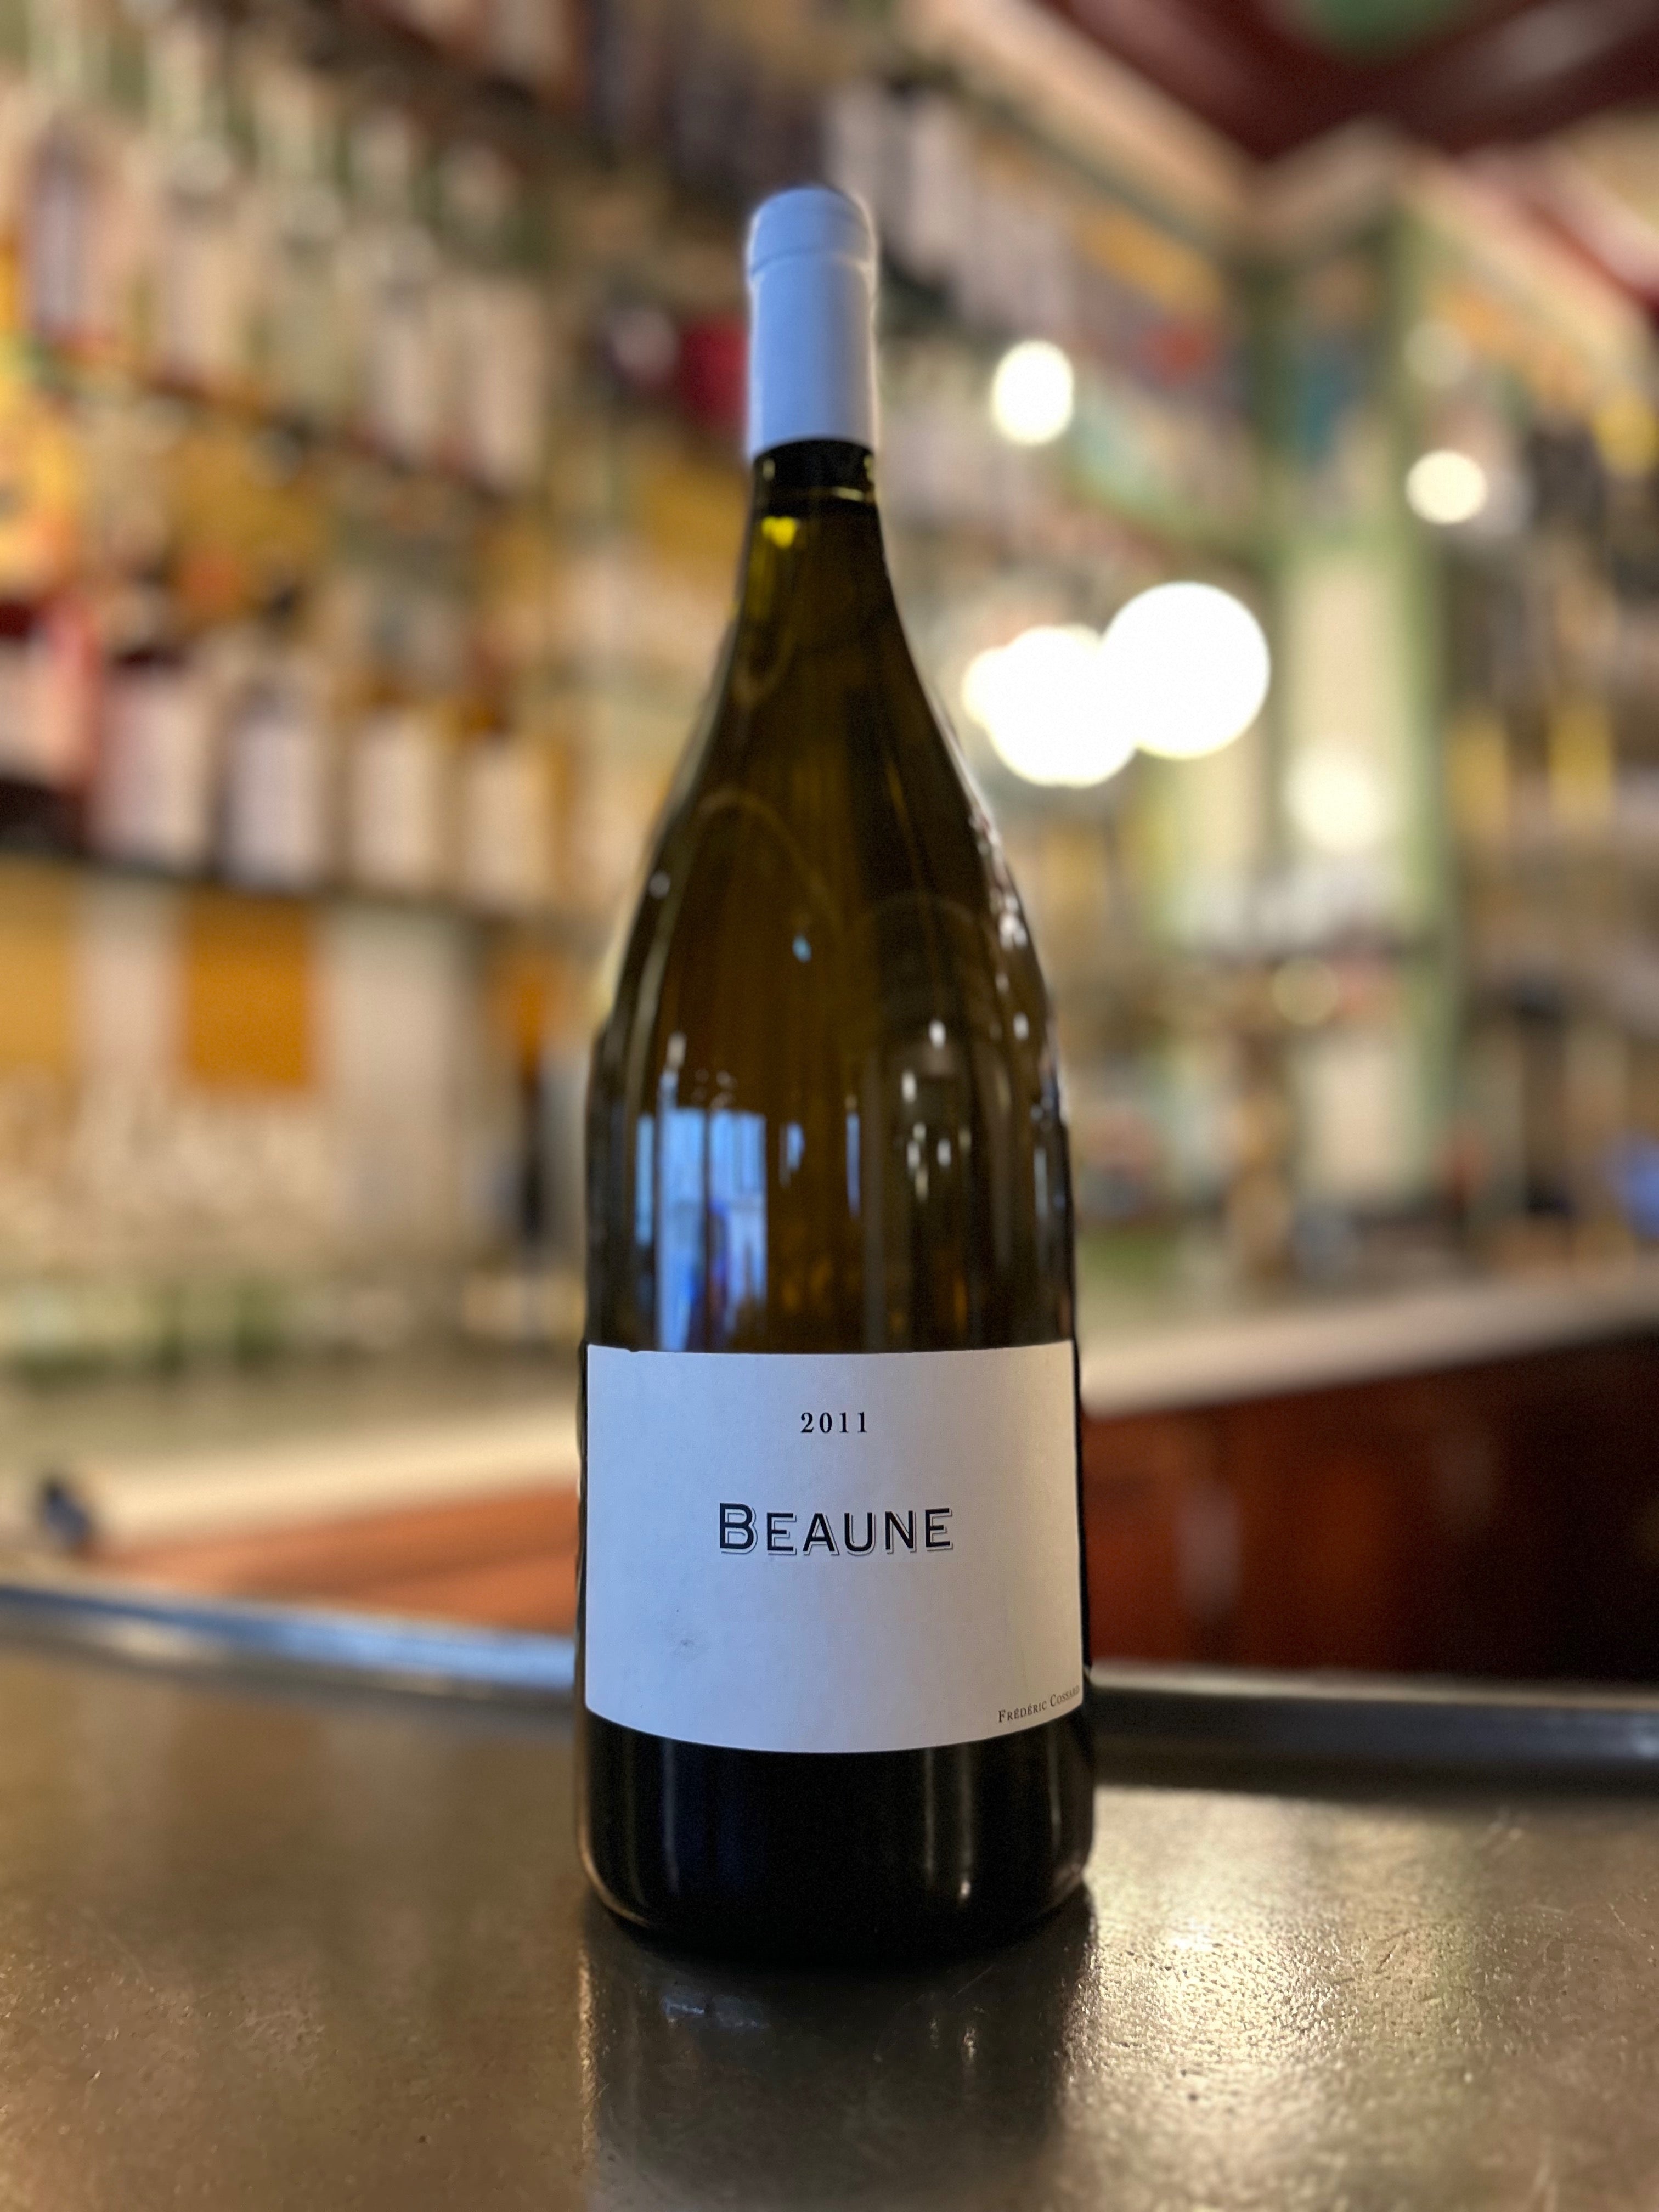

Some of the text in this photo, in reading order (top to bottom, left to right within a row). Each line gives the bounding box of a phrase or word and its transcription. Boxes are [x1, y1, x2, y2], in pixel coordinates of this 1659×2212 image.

[800, 1412, 867, 1433] 2011
[719, 1502, 953, 1556] BEAUNE
[998, 1701, 1047, 1723] FRÉDÉRIC
